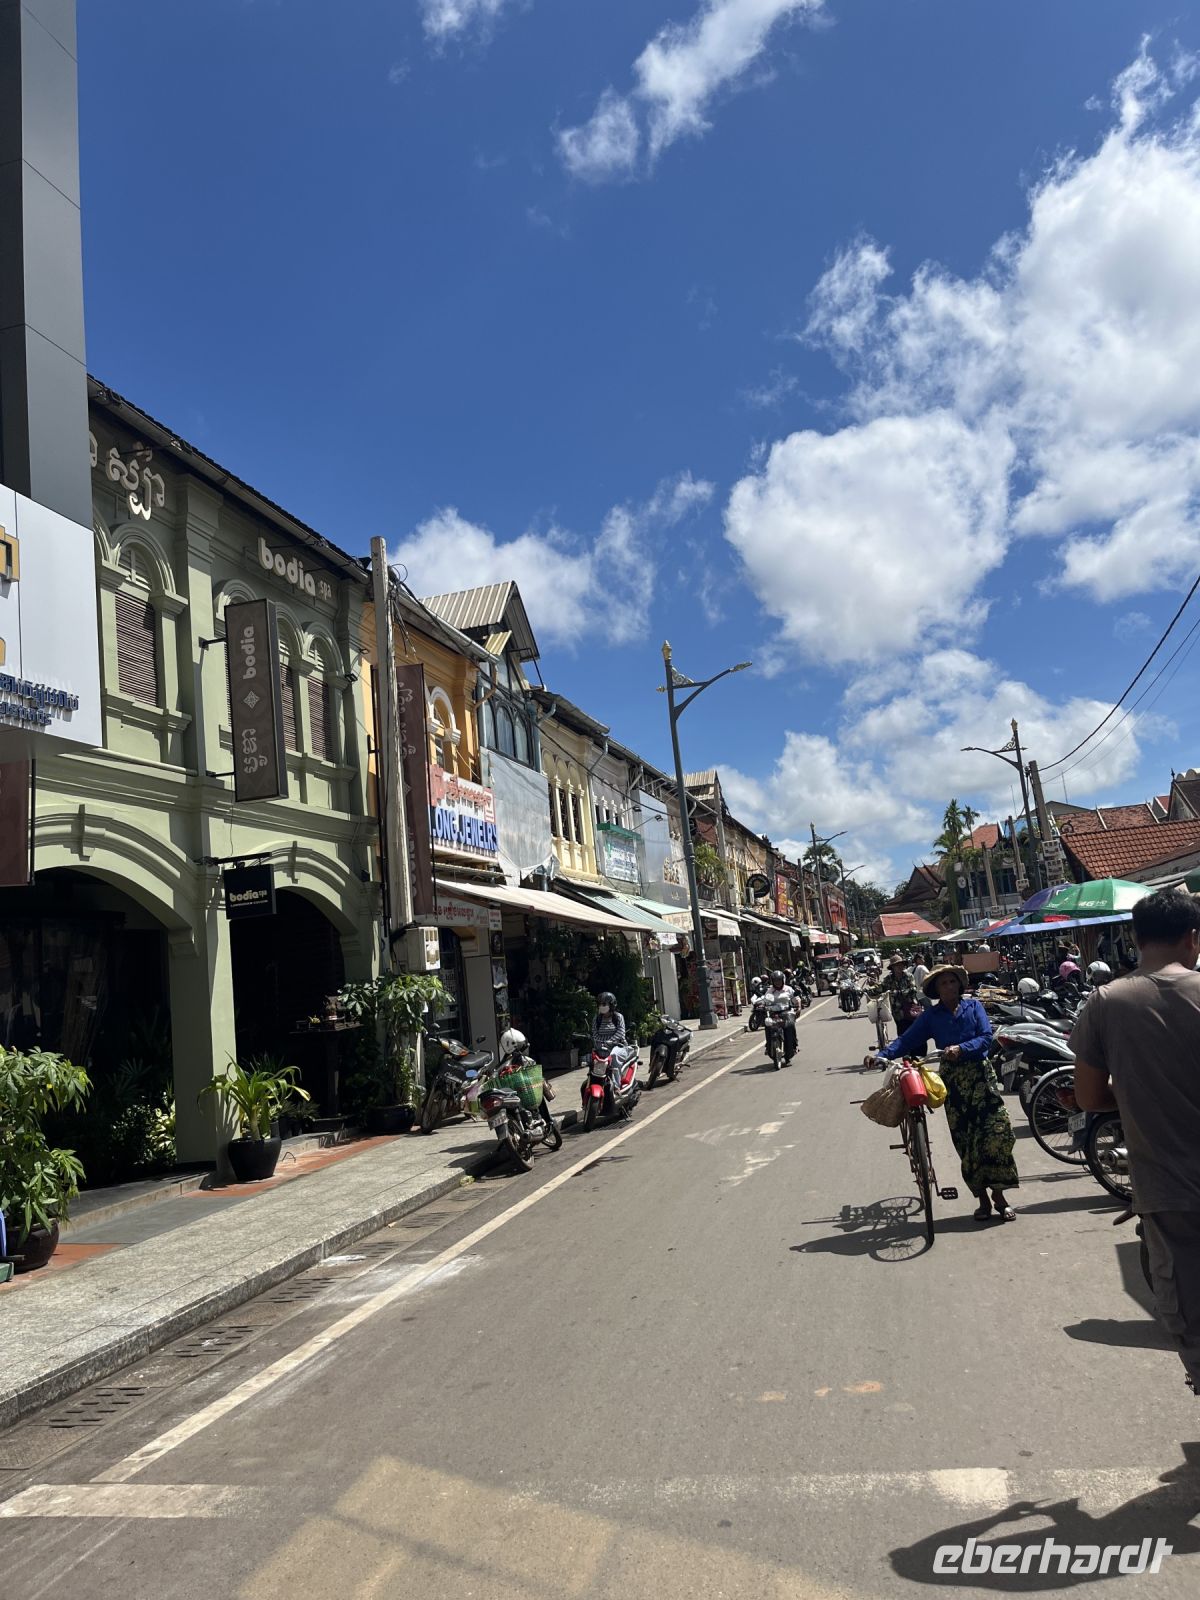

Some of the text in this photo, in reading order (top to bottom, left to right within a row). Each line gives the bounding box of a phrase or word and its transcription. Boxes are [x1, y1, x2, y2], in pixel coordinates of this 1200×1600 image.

[258, 537, 332, 600] bodia spa
[241, 626, 257, 679] bodia
[230, 890, 259, 902] bodia
